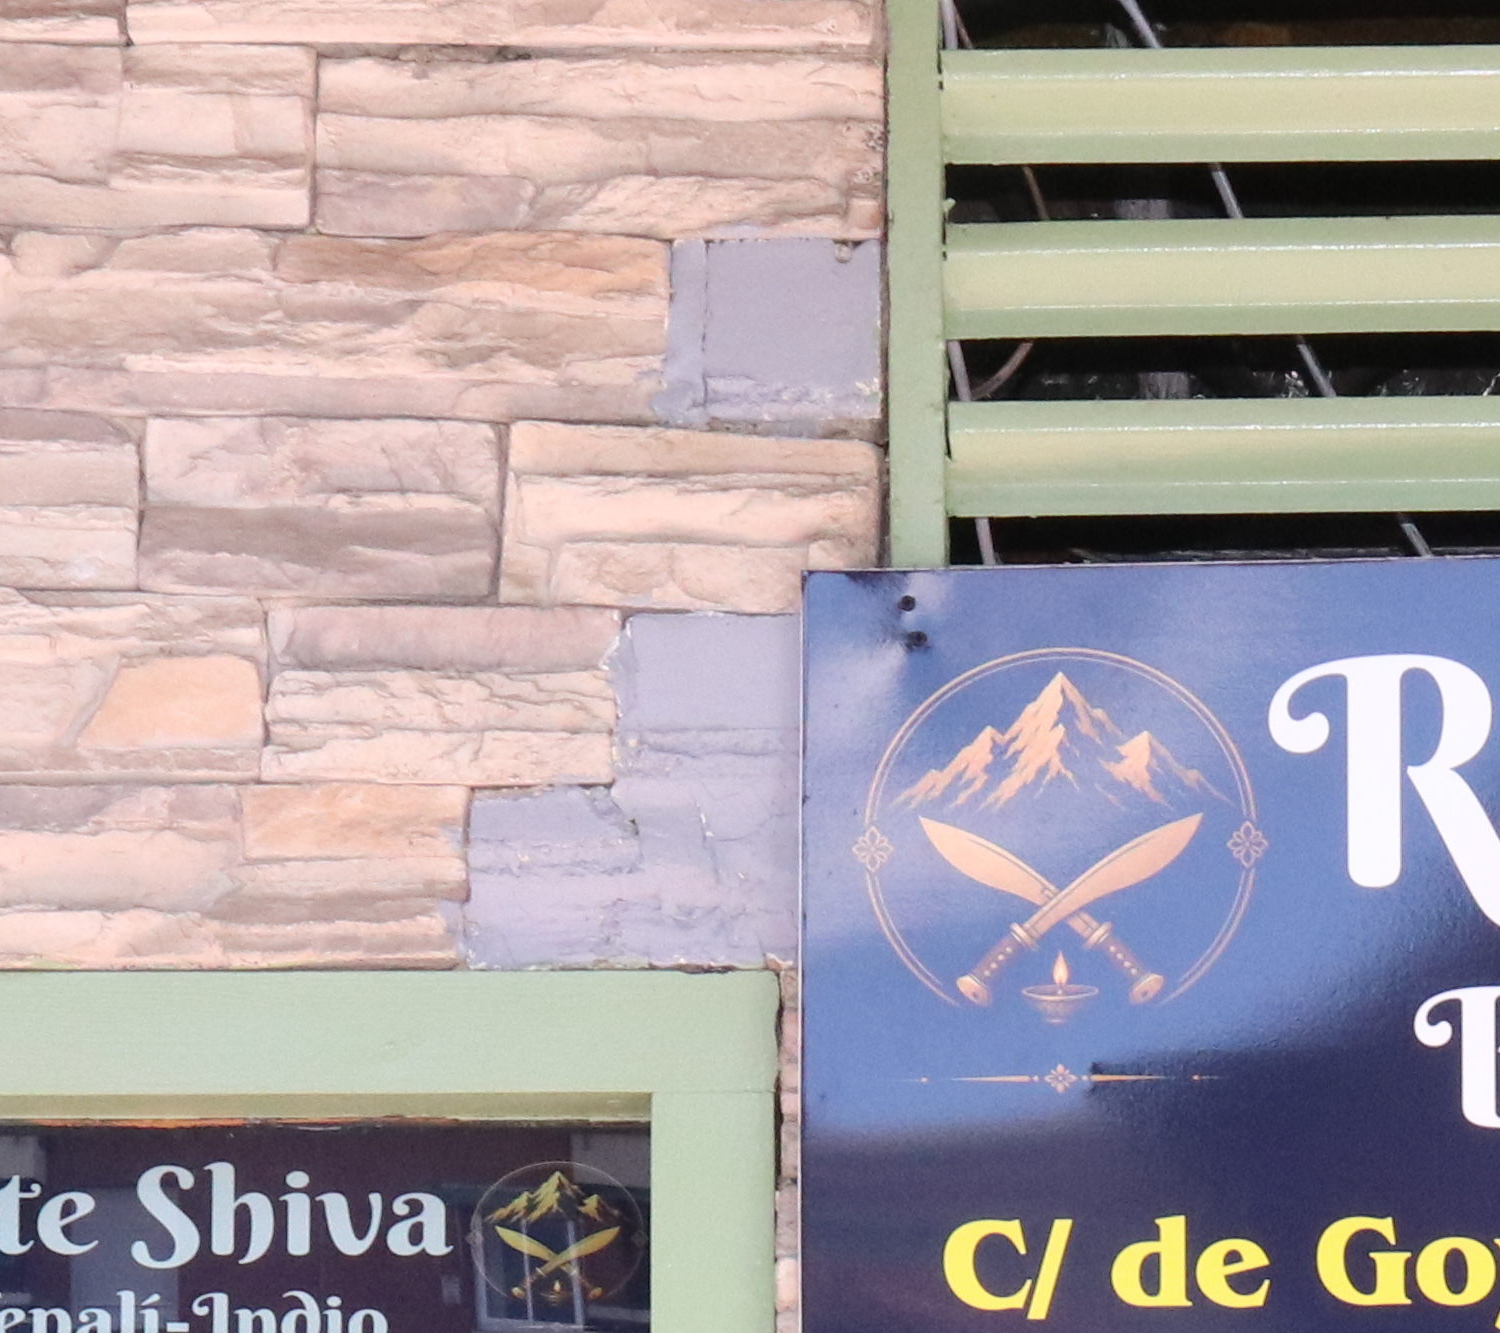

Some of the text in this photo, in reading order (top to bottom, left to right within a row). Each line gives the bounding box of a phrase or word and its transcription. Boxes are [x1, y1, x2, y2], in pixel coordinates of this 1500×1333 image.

[130, 1161, 454, 1270] Shiva
[943, 1219, 1073, 1321] C/
[1111, 1216, 1270, 1309] de
